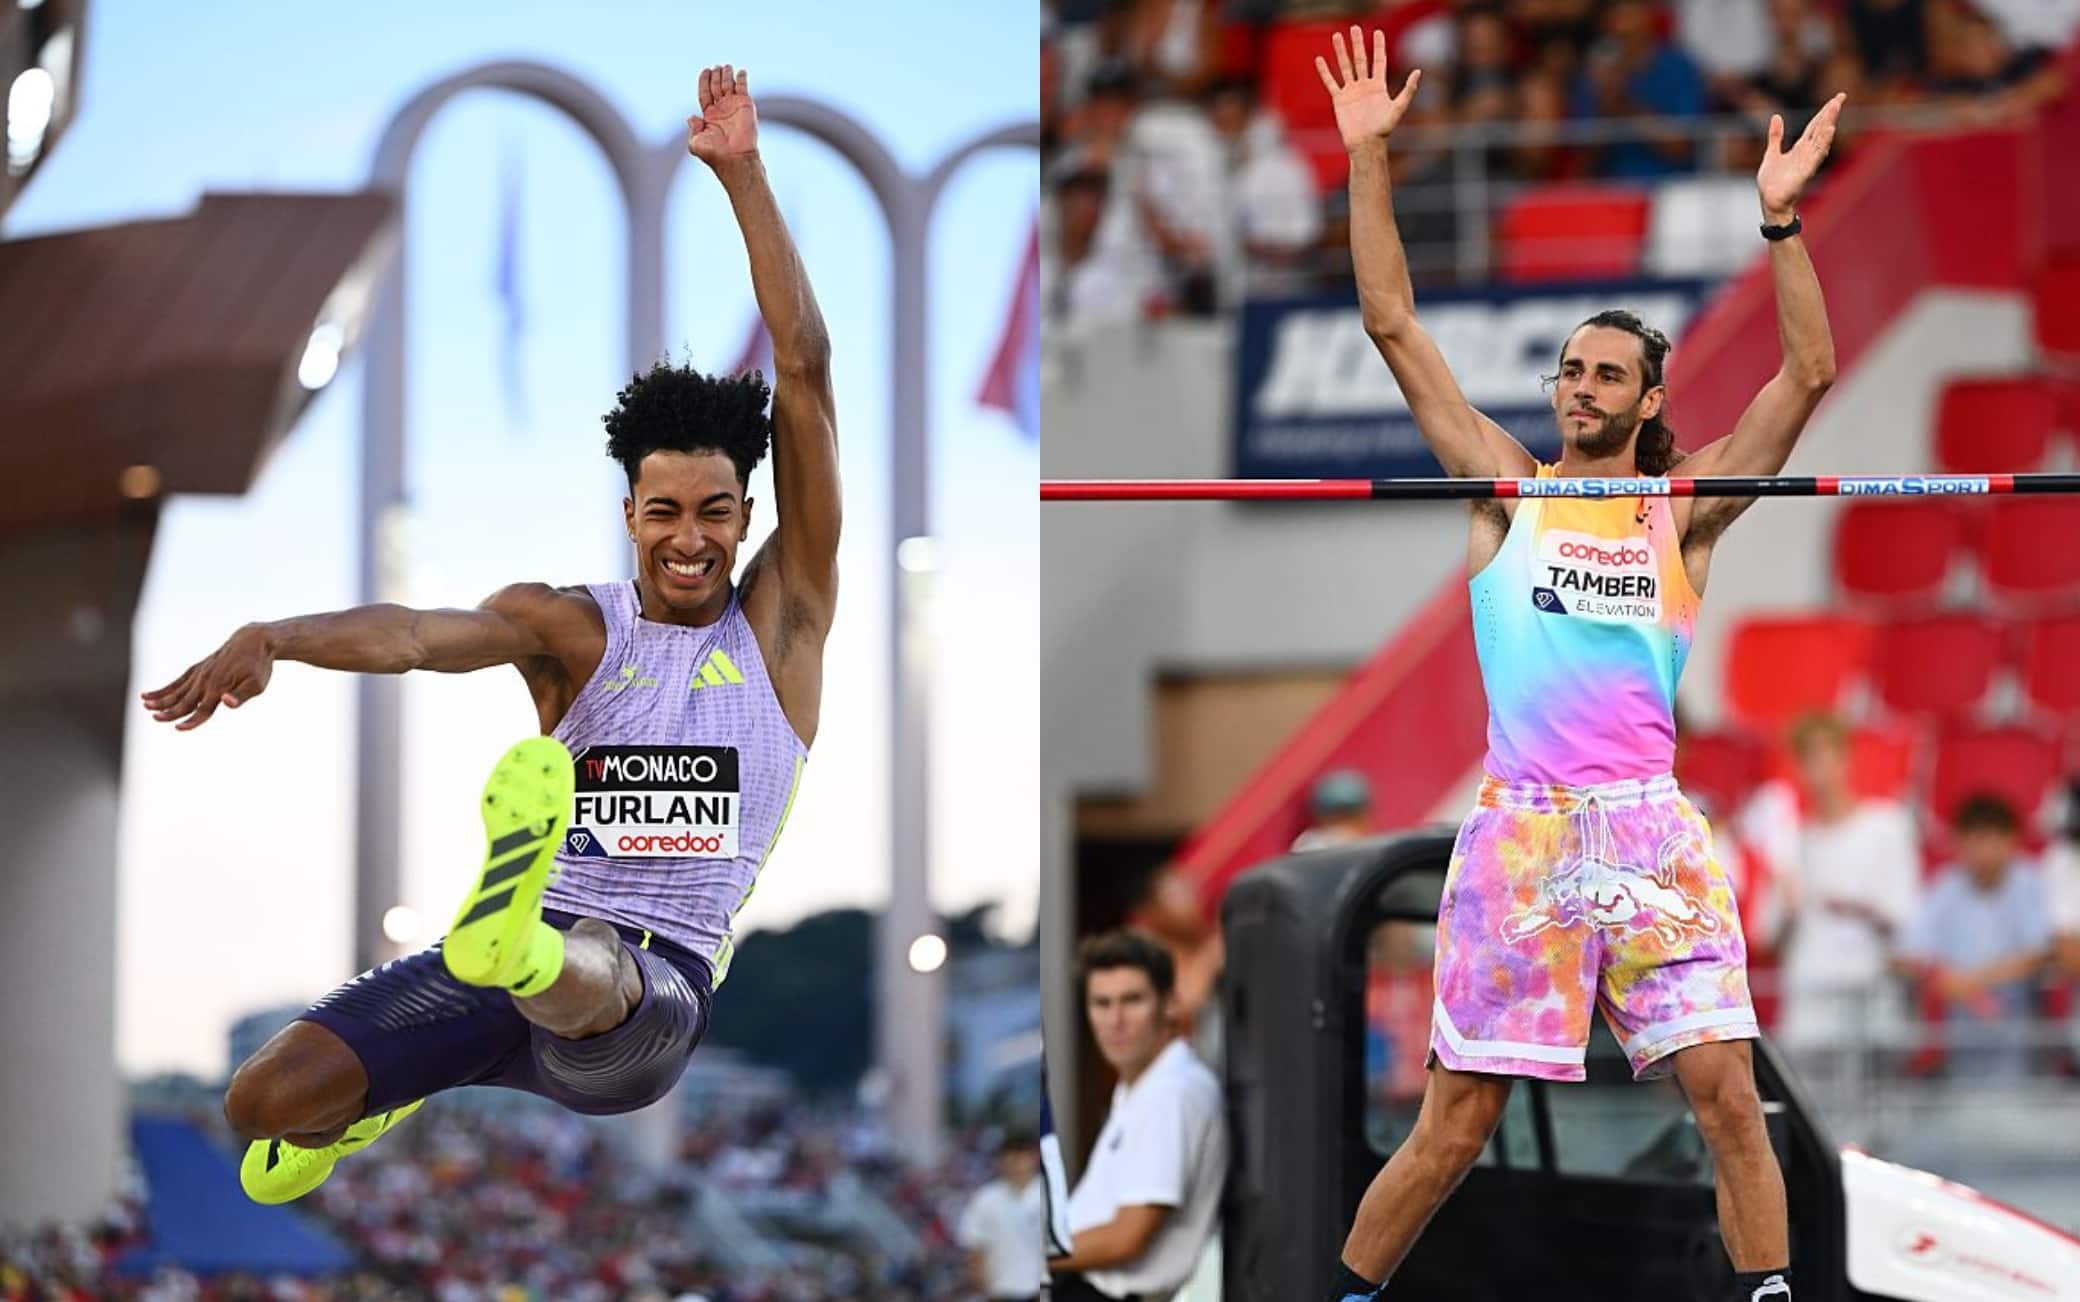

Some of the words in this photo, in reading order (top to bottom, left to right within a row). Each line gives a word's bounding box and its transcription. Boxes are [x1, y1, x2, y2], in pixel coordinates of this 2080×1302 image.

[1560, 543, 1649, 566] ooredoo
[1548, 566, 1656, 599] TAMBERI
[1576, 599, 1655, 617] ELEVATION
[575, 796, 730, 825] FURLANI
